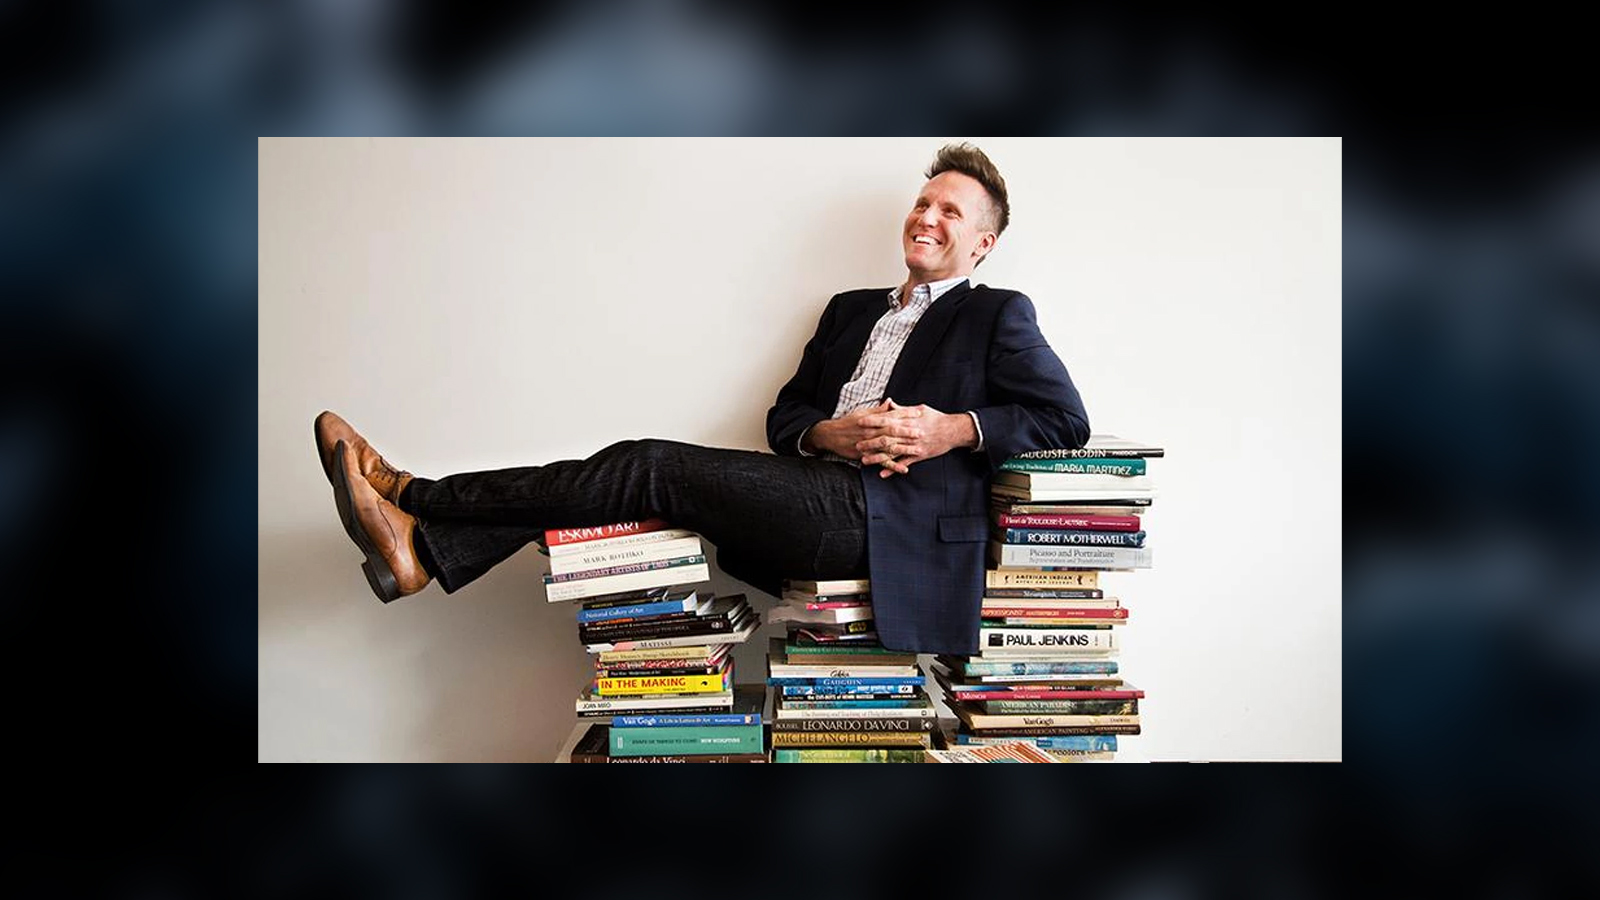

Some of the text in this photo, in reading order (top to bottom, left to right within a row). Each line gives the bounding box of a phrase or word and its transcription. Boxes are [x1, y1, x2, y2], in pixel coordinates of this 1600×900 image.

[1020, 448, 1107, 459] AUGUSTE RODIN
[1054, 462, 1085, 473] MARIA
[1086, 464, 1132, 476] MARTINEZ
[614, 521, 640, 535] ART
[1027, 533, 1126, 545] ROBERT MOTHERWELL
[1029, 549, 1116, 558] Picasso and Portraiture
[1006, 634, 1089, 646] PAUL JENKINS
[601, 677, 687, 689] IN THE MAKING
[623, 717, 657, 726] Van Gogh
[802, 719, 861, 731] LEONARDO
[879, 719, 910, 730] VINCI
[774, 732, 870, 744] MICHELANGELO
